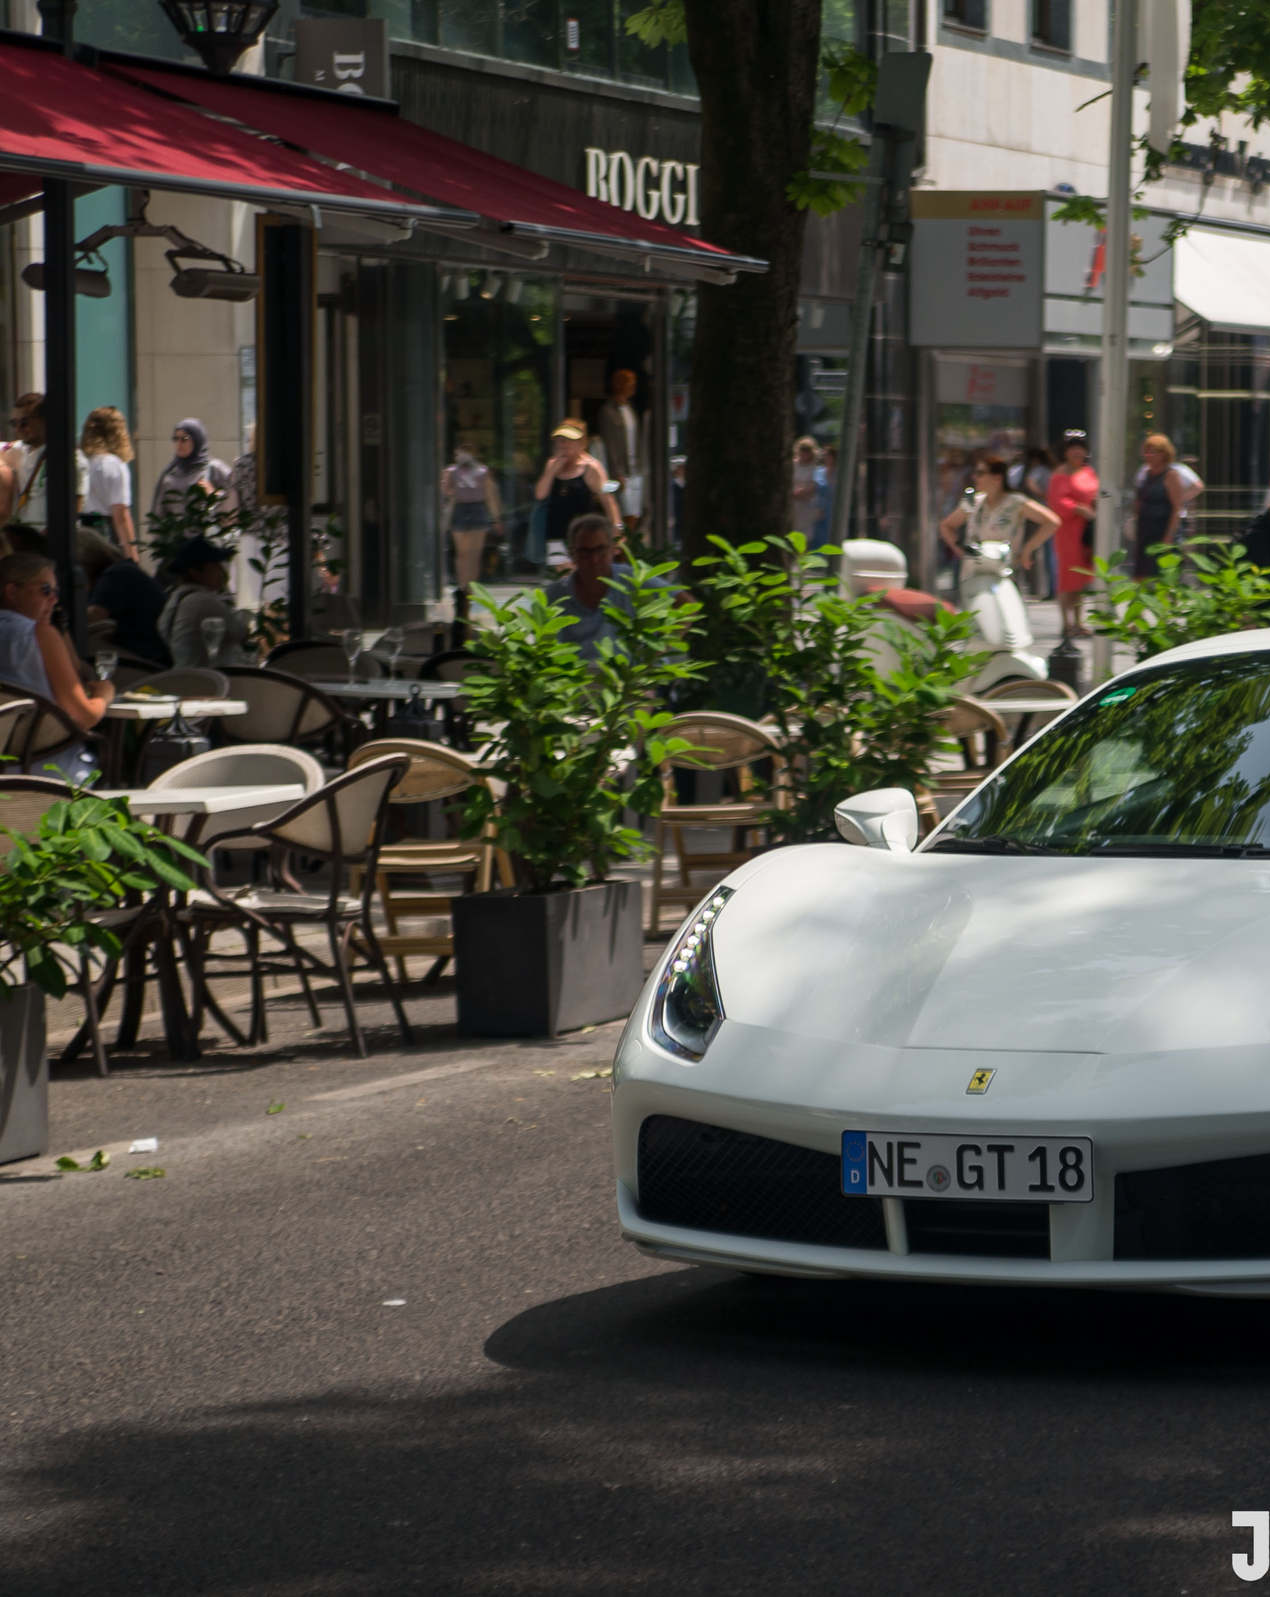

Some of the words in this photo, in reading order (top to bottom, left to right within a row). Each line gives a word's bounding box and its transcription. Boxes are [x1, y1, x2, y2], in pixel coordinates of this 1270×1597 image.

[851, 1169, 860, 1183] D
[868, 1141, 924, 1188] NE
[956, 1144, 1015, 1191] GT
[1028, 1146, 1085, 1192] 18
